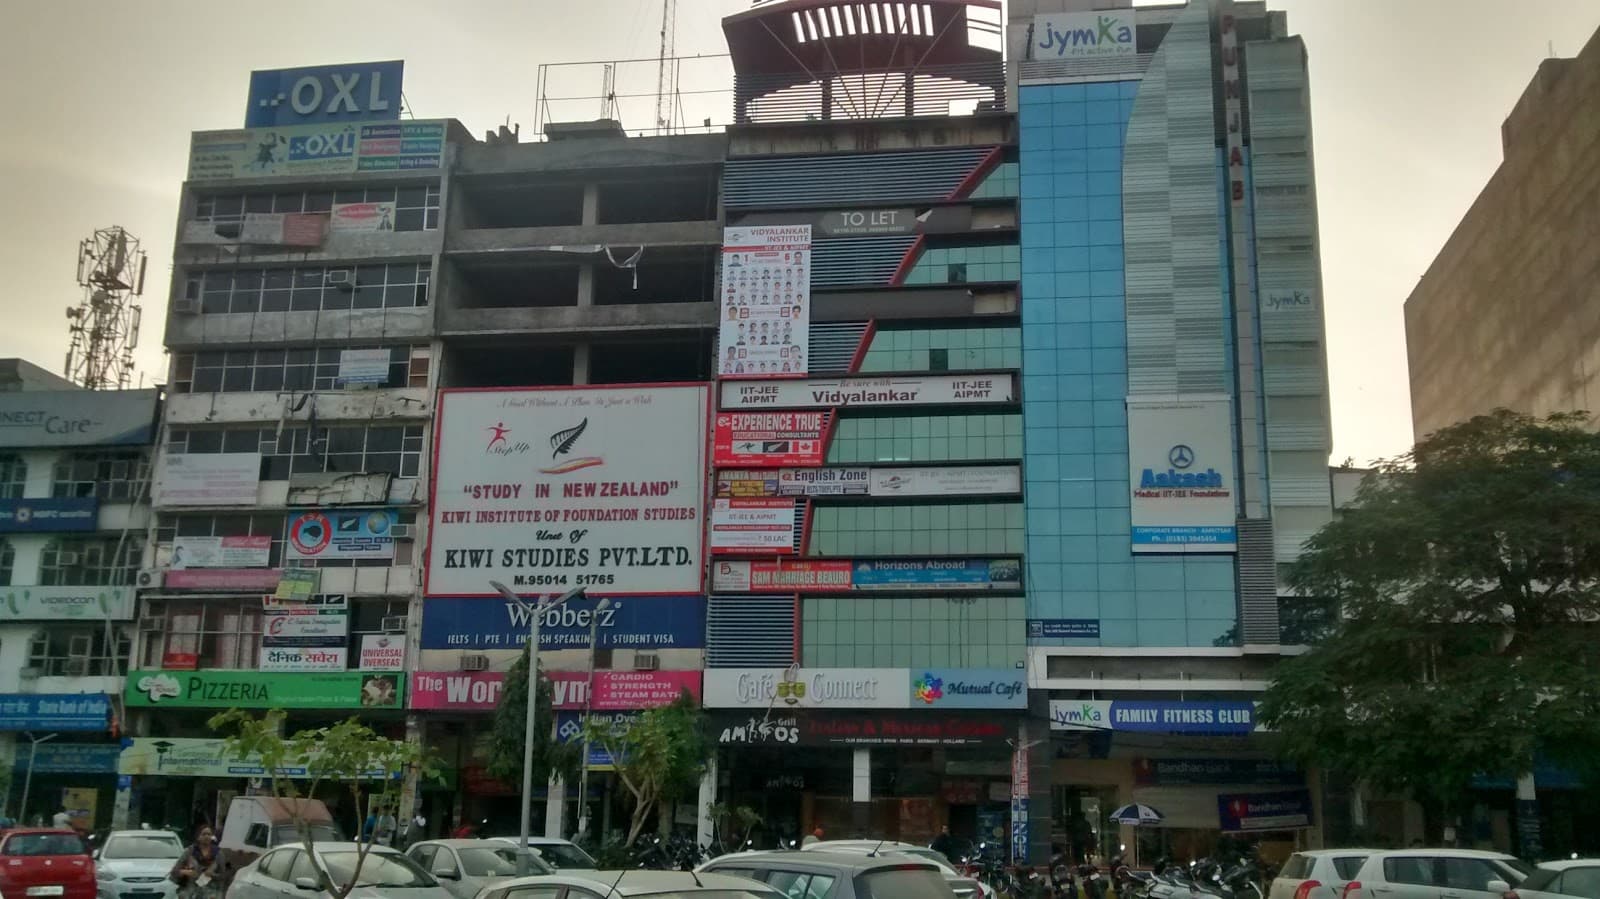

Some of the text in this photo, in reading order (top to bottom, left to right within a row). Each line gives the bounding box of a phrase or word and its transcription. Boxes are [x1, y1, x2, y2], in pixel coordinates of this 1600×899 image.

[291, 71, 389, 114] OXL
[305, 132, 353, 156] OXL
[840, 211, 898, 226] TO LET
[750, 227, 809, 237] VIDYALANKAR
[767, 235, 809, 243] INSTITUTE
[740, 386, 780, 395] IIT-JEE
[952, 380, 993, 390] IIT-JEE
[741, 395, 777, 404] AIPMT
[812, 390, 918, 407] Vidyalankar
[953, 389, 991, 399] AIPMT
[46, 415, 91, 434] Care
[731, 413, 821, 431] EXPERIENCE TRUE
[794, 470, 836, 483] English
[839, 469, 868, 481] Zone
[535, 484, 550, 499] IN
[563, 482, 597, 498] NEW
[441, 507, 696, 524] KIWI INSTITUTE OF FOUNDATION STUDIES
[535, 530, 563, 541] Unit
[444, 549, 493, 569] KIWI
[502, 547, 589, 568] STUDIES
[875, 560, 966, 570] Horizons Abroad
[514, 574, 615, 586] M.95014 51765
[752, 571, 771, 585] SAM
[447, 634, 470, 645] IELTS
[485, 633, 500, 644] PTE
[554, 633, 594, 644] SPEAKIN
[612, 633, 651, 644] STUDENT
[653, 633, 675, 644] VISA
[362, 648, 402, 657] UNIVERSAL
[417, 675, 444, 692] The
[610, 673, 653, 681] CARDIO
[810, 672, 879, 703] Connect
[947, 681, 992, 695] Mutual
[610, 691, 649, 699] STEAM
[1116, 708, 1158, 724] FAMILY
[1163, 708, 1213, 724] FITNESS
[1219, 708, 1250, 724] CLUB
